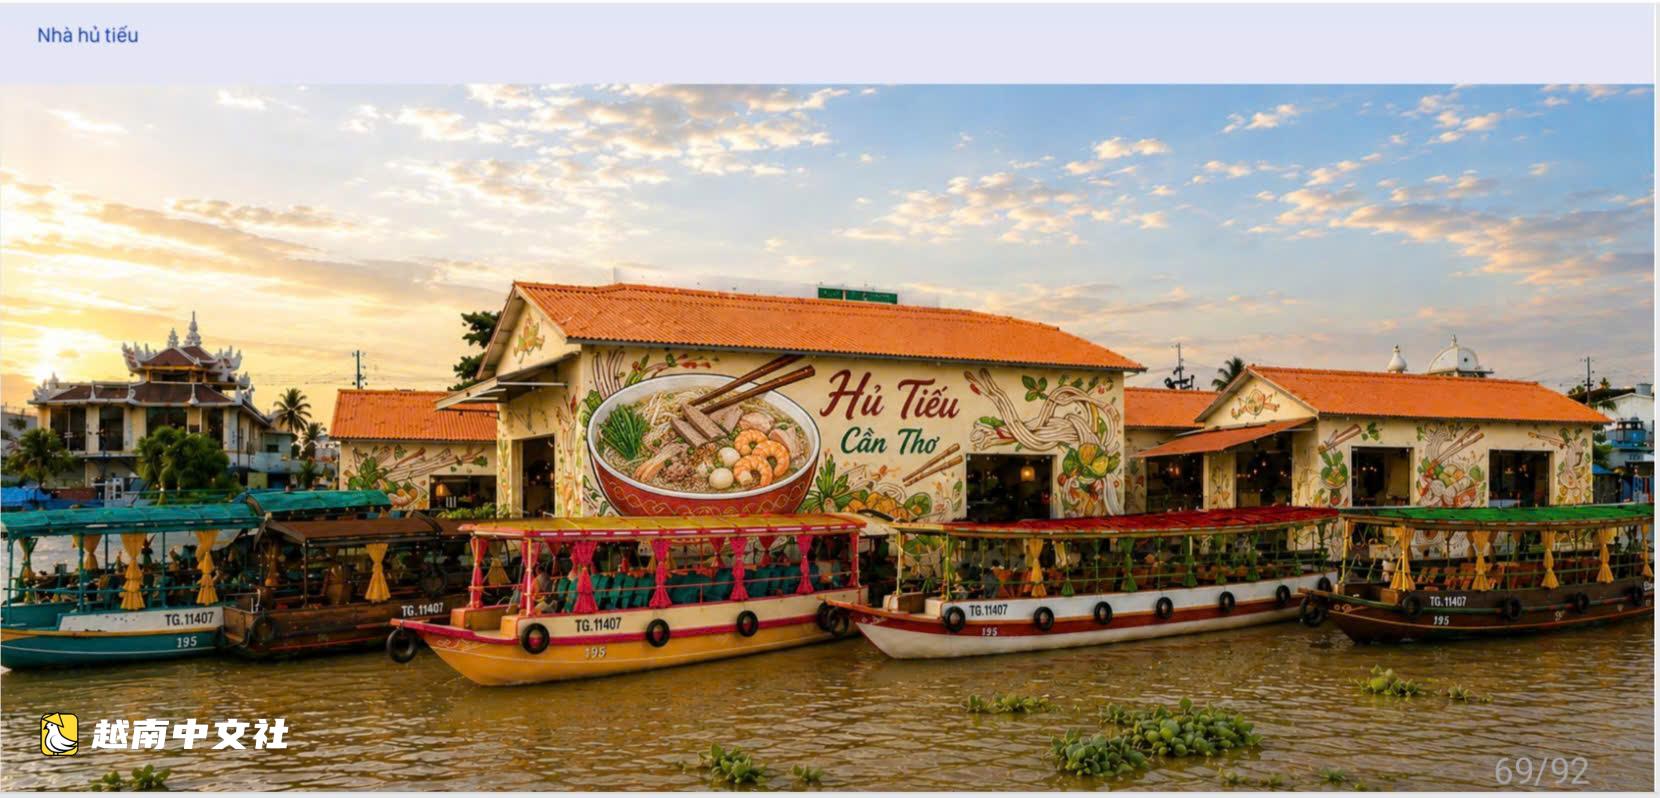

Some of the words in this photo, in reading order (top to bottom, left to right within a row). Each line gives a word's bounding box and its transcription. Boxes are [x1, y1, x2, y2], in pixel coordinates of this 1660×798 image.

[819, 369, 885, 420] Hủ
[897, 378, 960, 420] Tiếu
[841, 426, 887, 454] Cần
[897, 428, 940, 455] Thơ
[1429, 596, 1467, 607] TG.11407
[401, 602, 444, 618] TG.11407
[968, 604, 1008, 616] TG.11407
[165, 611, 214, 626] TG.11407
[575, 617, 621, 632] TG.11407
[1433, 615, 1450, 625] 195
[177, 636, 198, 648] 195
